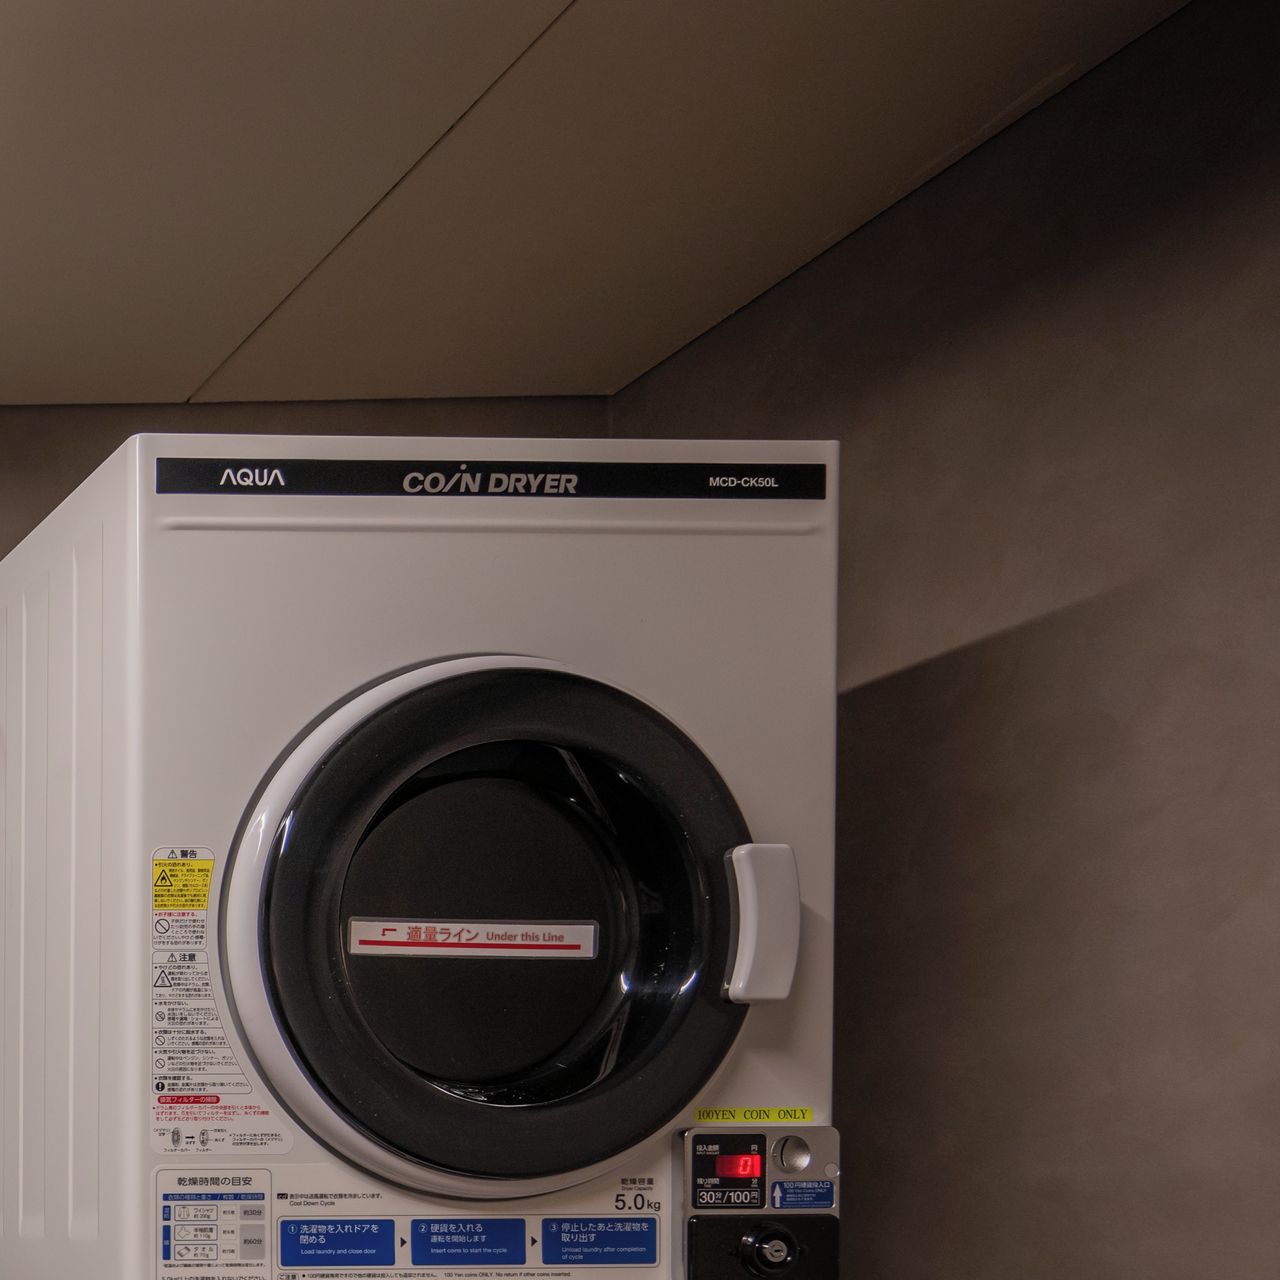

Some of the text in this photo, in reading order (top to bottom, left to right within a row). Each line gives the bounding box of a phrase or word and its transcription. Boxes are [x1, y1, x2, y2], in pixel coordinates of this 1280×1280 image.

[220, 469, 284, 486] AQUA
[403, 464, 579, 495] COIN DRYER
[710, 477, 778, 487] MCD-CK50L
[179, 849, 198, 859] 警告
[406, 925, 564, 943] 適量ライン Under this Line
[178, 952, 196, 961] 注意
[698, 1108, 807, 1120] 100YEN COIN ONLY
[176, 1176, 254, 1187] 乾燥時間の目安
